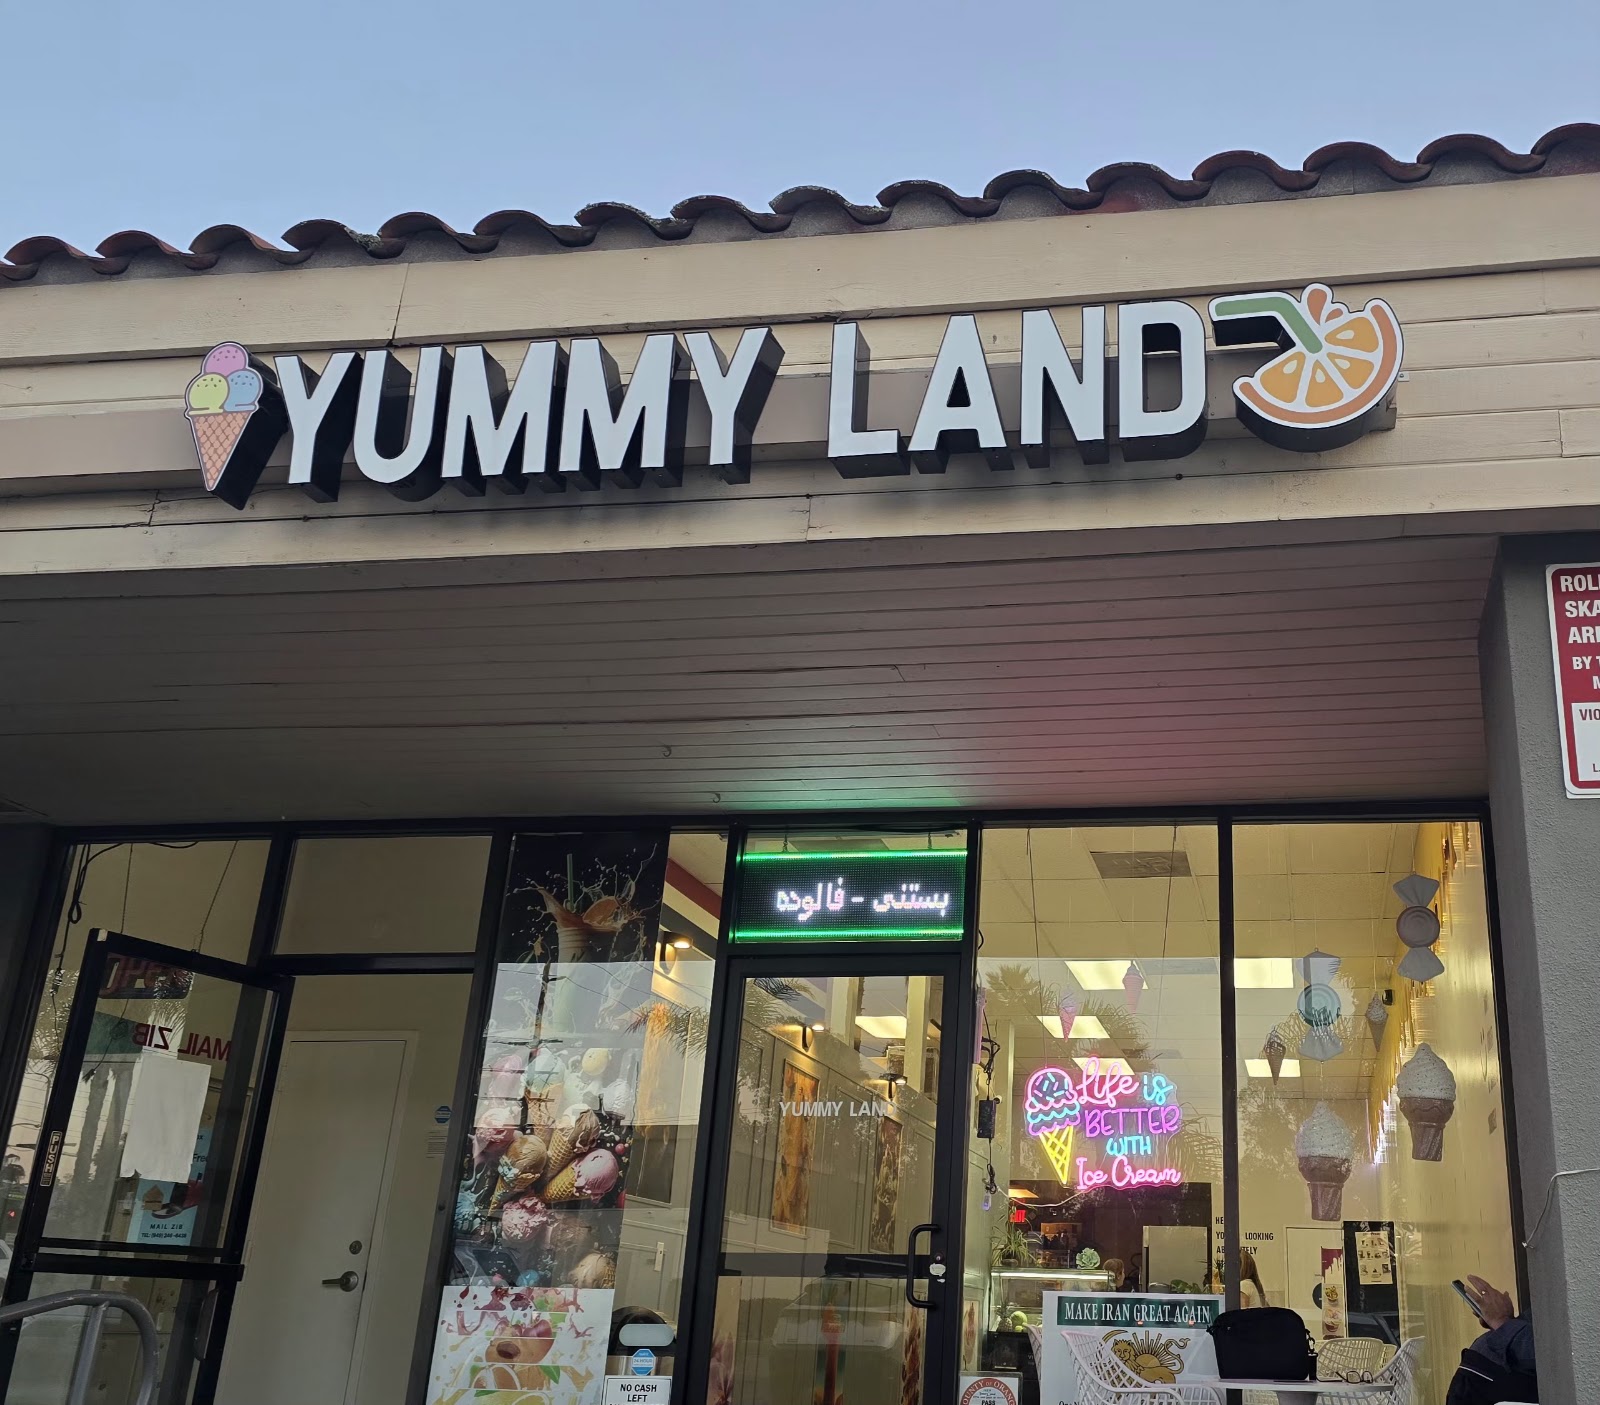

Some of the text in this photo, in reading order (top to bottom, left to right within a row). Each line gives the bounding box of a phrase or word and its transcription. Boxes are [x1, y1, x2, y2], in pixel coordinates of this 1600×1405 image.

[274, 300, 1206, 484] YUMMY LAND
[1560, 574, 1600, 592] ROL
[1572, 656, 1592, 669] BY
[777, 877, 845, 921] فالوده
[1143, 1074, 1173, 1105] is
[779, 1101, 897, 1117] YUMMY LAND
[1084, 1105, 1180, 1138] BETTER
[44, 1135, 60, 1173] PUSH
[1106, 1136, 1151, 1156] WITH
[1076, 1156, 1181, 1189] Ice Cream
[1245, 1232, 1274, 1241] LOOKING
[1064, 1302, 1211, 1324] MAKE IRAN GREAT AGAIN
[620, 1384, 657, 1392] NO CASH
[627, 1394, 648, 1403] LEFT
